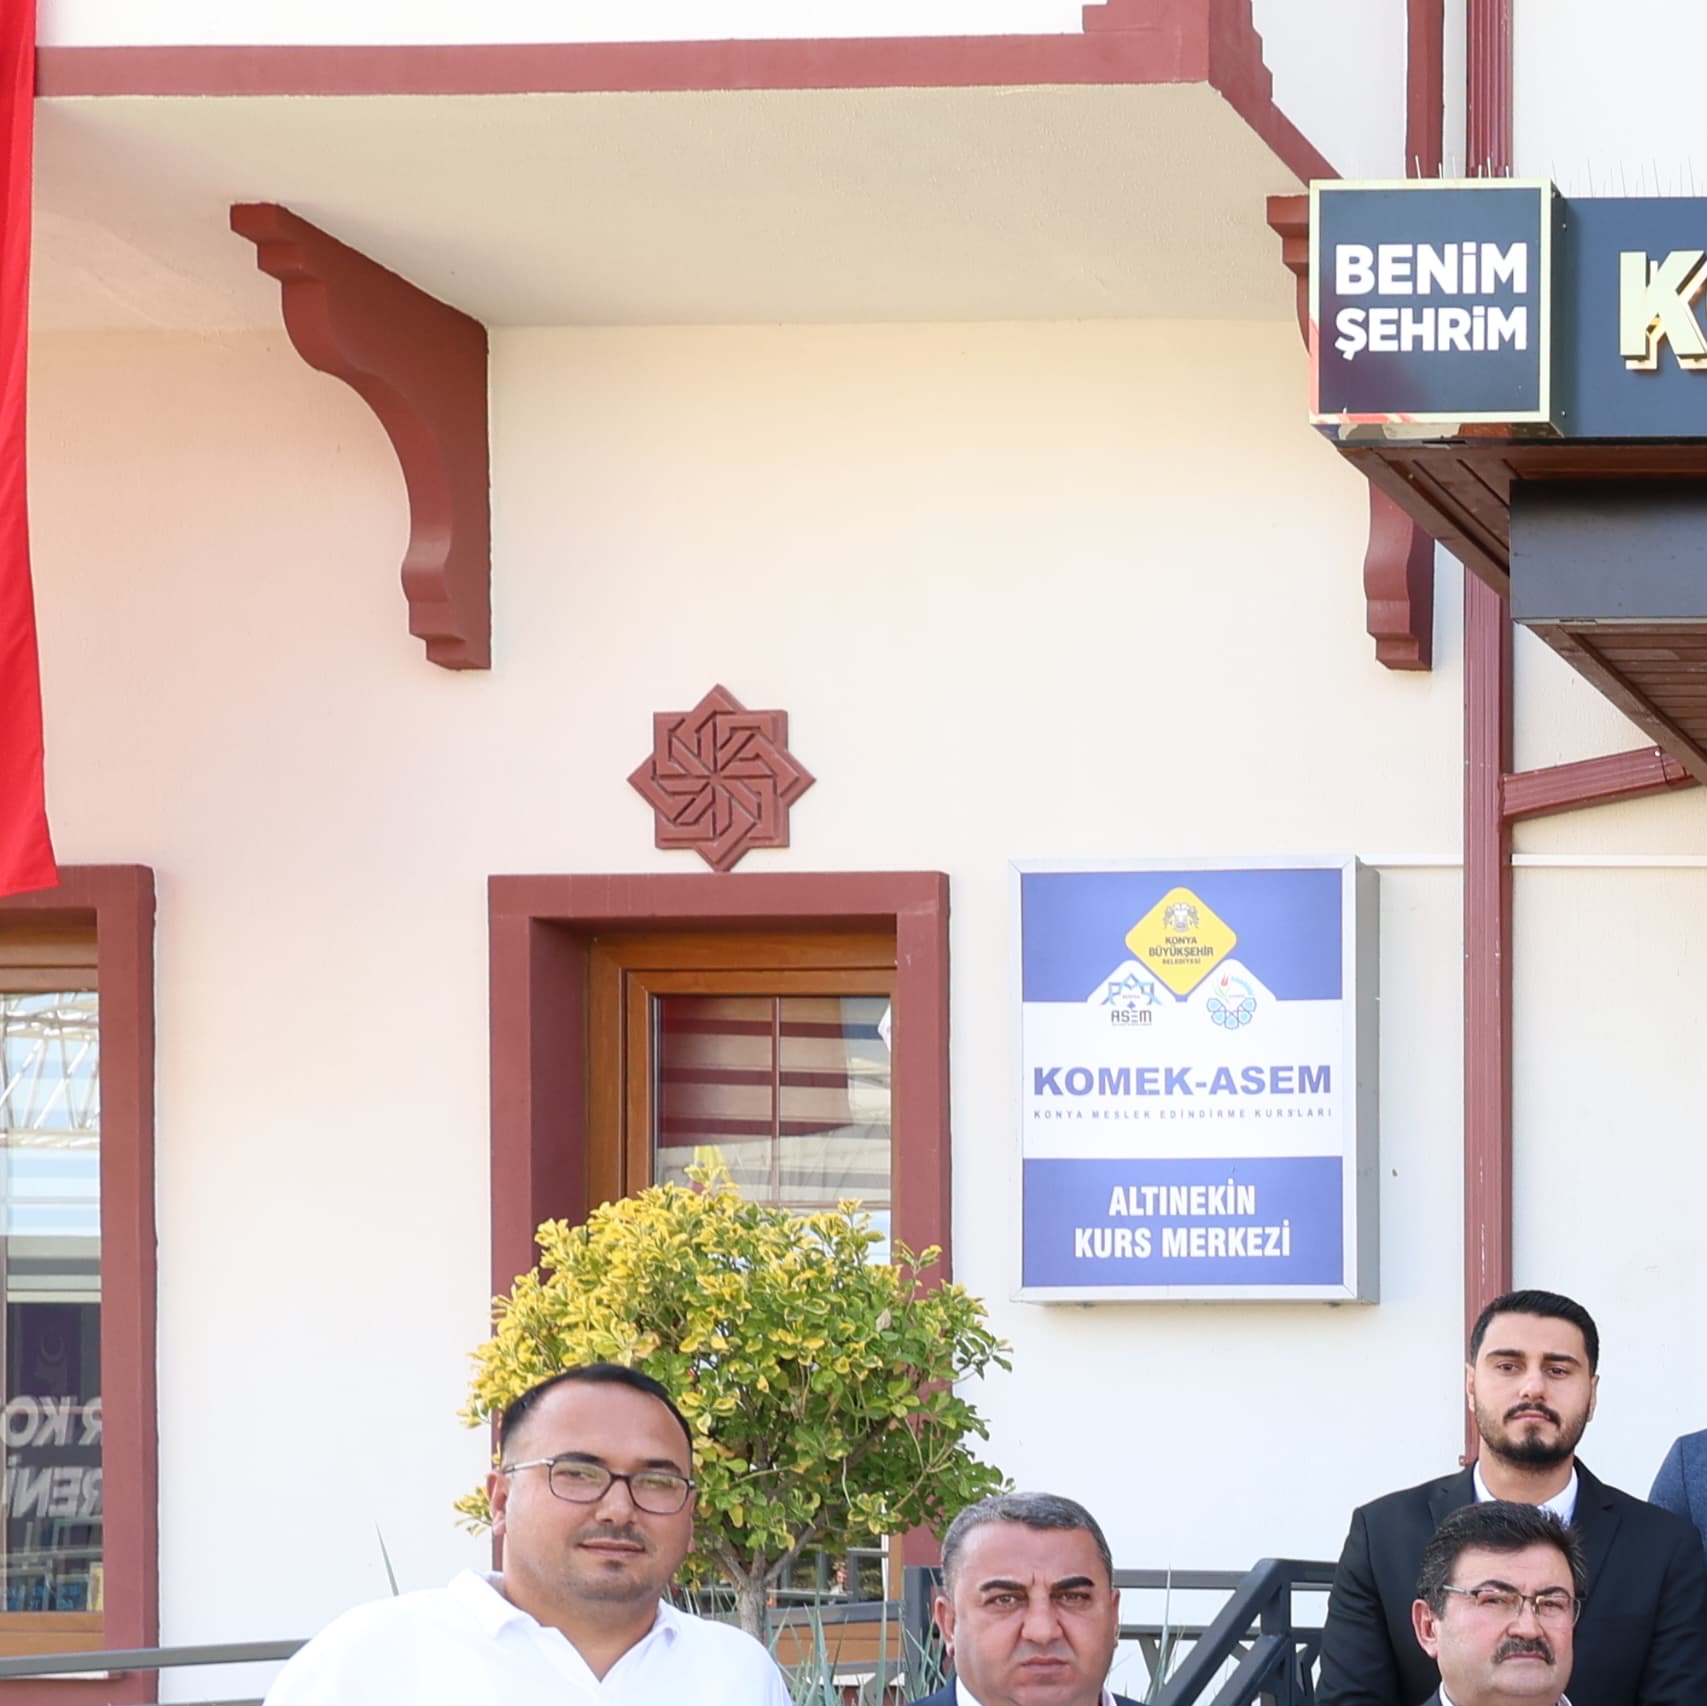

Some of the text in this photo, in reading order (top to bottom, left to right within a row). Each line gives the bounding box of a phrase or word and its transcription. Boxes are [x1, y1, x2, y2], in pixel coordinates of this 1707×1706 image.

[1164, 936, 1198, 945] KONYA
[1148, 944, 1214, 959] BÜYÜKŞEHİR
[1111, 1009, 1152, 1023] ASEM
[1033, 1065, 1332, 1097] KOMEK-ASEM
[1034, 1110, 1083, 1120] KONYA
[1092, 1110, 1151, 1120] MESLEK
[1160, 1108, 1246, 1119] EDİNDİRME
[1108, 1178, 1256, 1217] ALTINEKİN
[1074, 1220, 1291, 1259] KURS MERKEZİ
